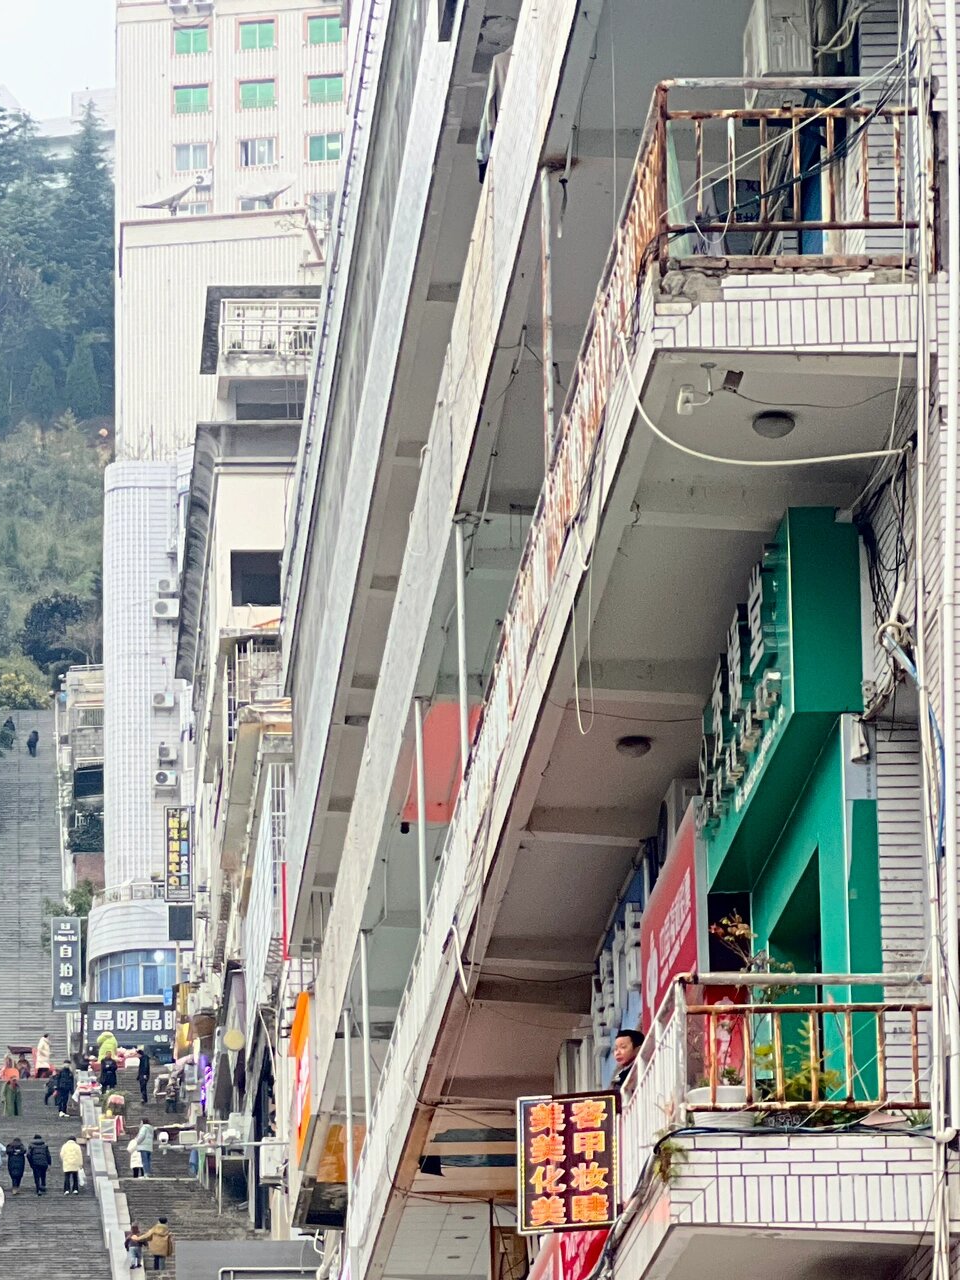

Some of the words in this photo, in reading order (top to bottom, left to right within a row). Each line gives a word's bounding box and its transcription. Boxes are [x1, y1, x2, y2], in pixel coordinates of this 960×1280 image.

[59, 944, 74, 996] 自拍馆
[529, 1100, 607, 1132] 美容
[530, 1131, 606, 1164] 美甲
[529, 1162, 608, 1195] 化妆
